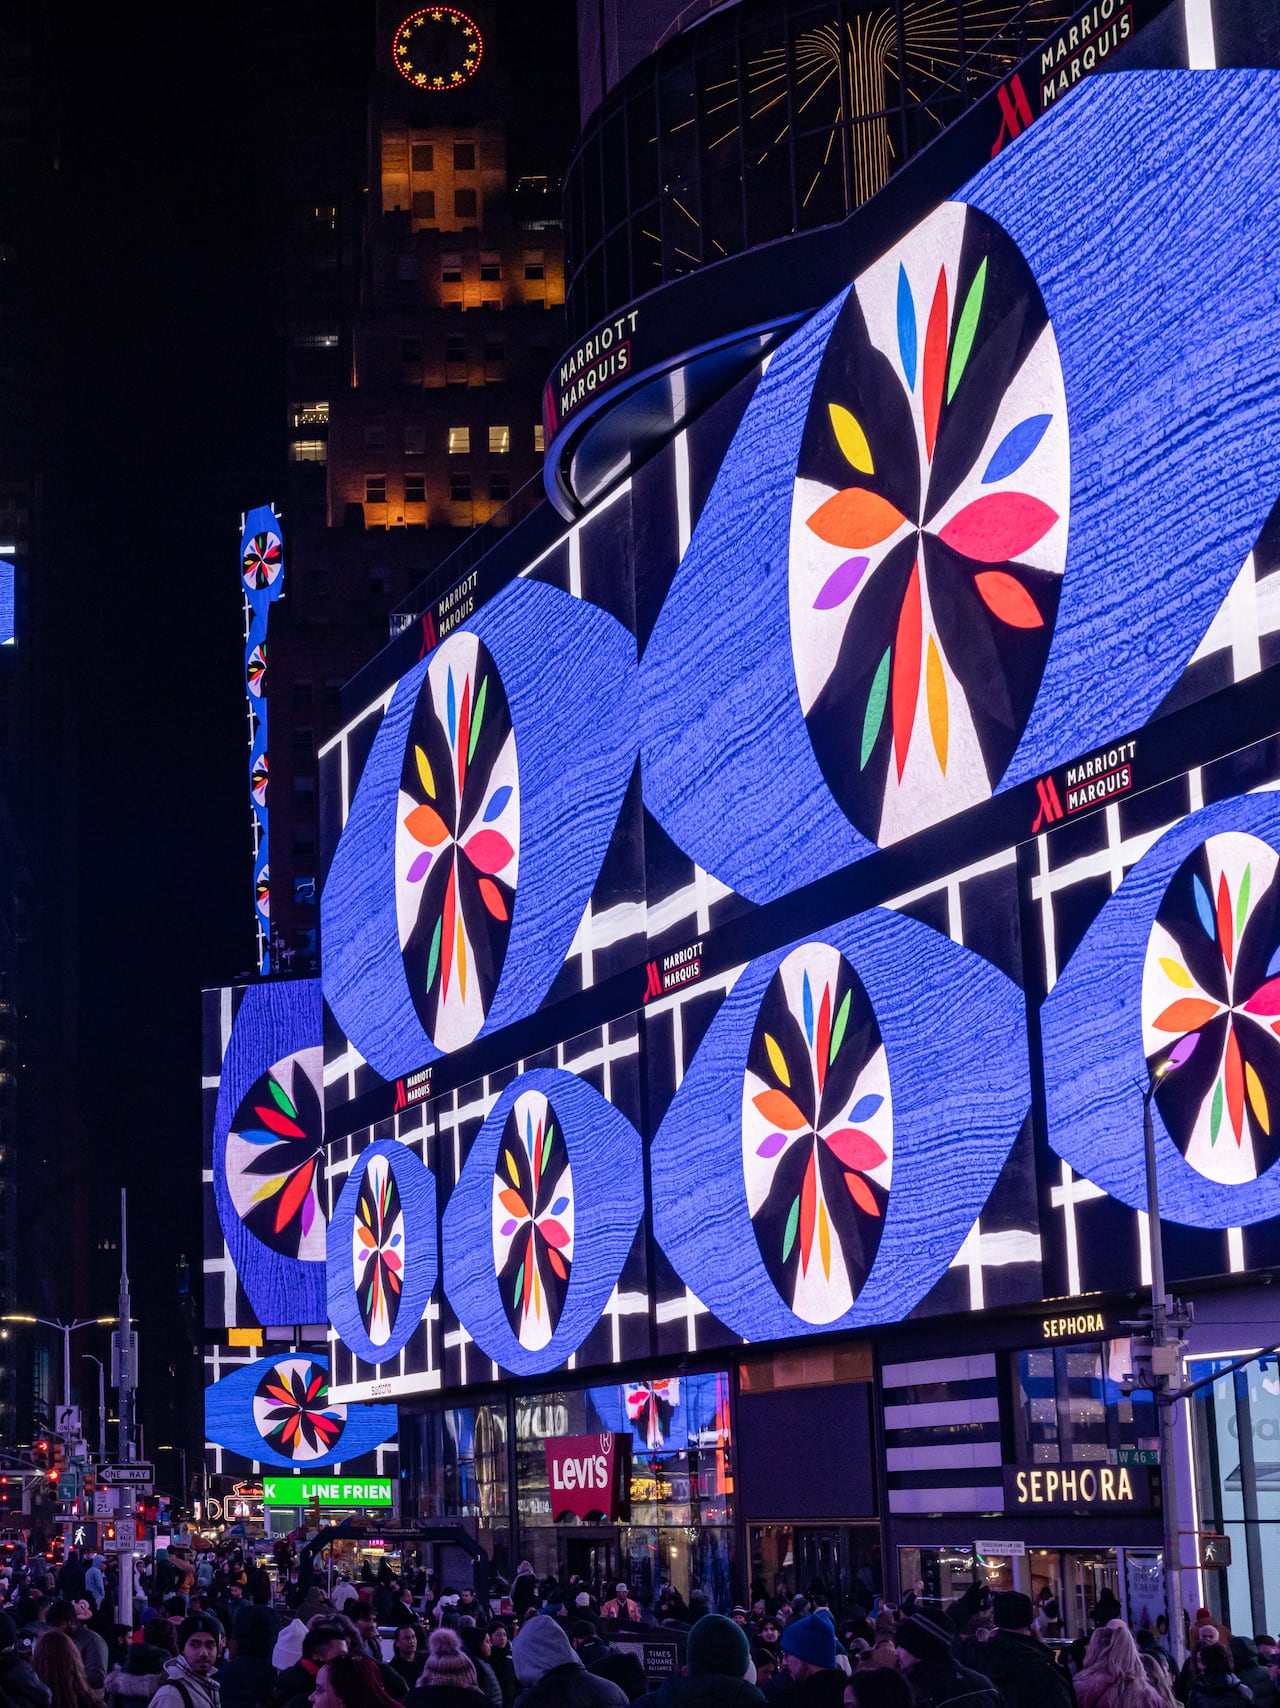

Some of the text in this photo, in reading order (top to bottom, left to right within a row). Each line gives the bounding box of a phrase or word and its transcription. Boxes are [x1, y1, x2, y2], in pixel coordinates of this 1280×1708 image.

[1042, 0, 1124, 75] MARRIO
[1043, 14, 1130, 107] MARQUIS
[560, 310, 639, 387] MARRIOTT
[561, 348, 627, 416] MARQUIS
[438, 571, 477, 617] MARRIOTT
[439, 597, 474, 637] MARQUIS
[1066, 741, 1136, 786] MARRIOTT
[1068, 769, 1130, 809] MARQUIS
[663, 942, 703, 970] MARRIOTT
[664, 962, 699, 988] MARQUIS
[407, 1067, 432, 1088] MARRIOTT
[407, 1084, 430, 1102] MARQUIS
[1042, 1313, 1105, 1338] SEPHORA
[1119, 1451, 1128, 1463] W
[1133, 1451, 1146, 1463] 46
[105, 1470, 146, 1478] ONE WAY
[1017, 1468, 1133, 1503] SEPHORA
[265, 1484, 391, 1499] K LINE FRIEN
[648, 1650, 671, 1658] TIMES
